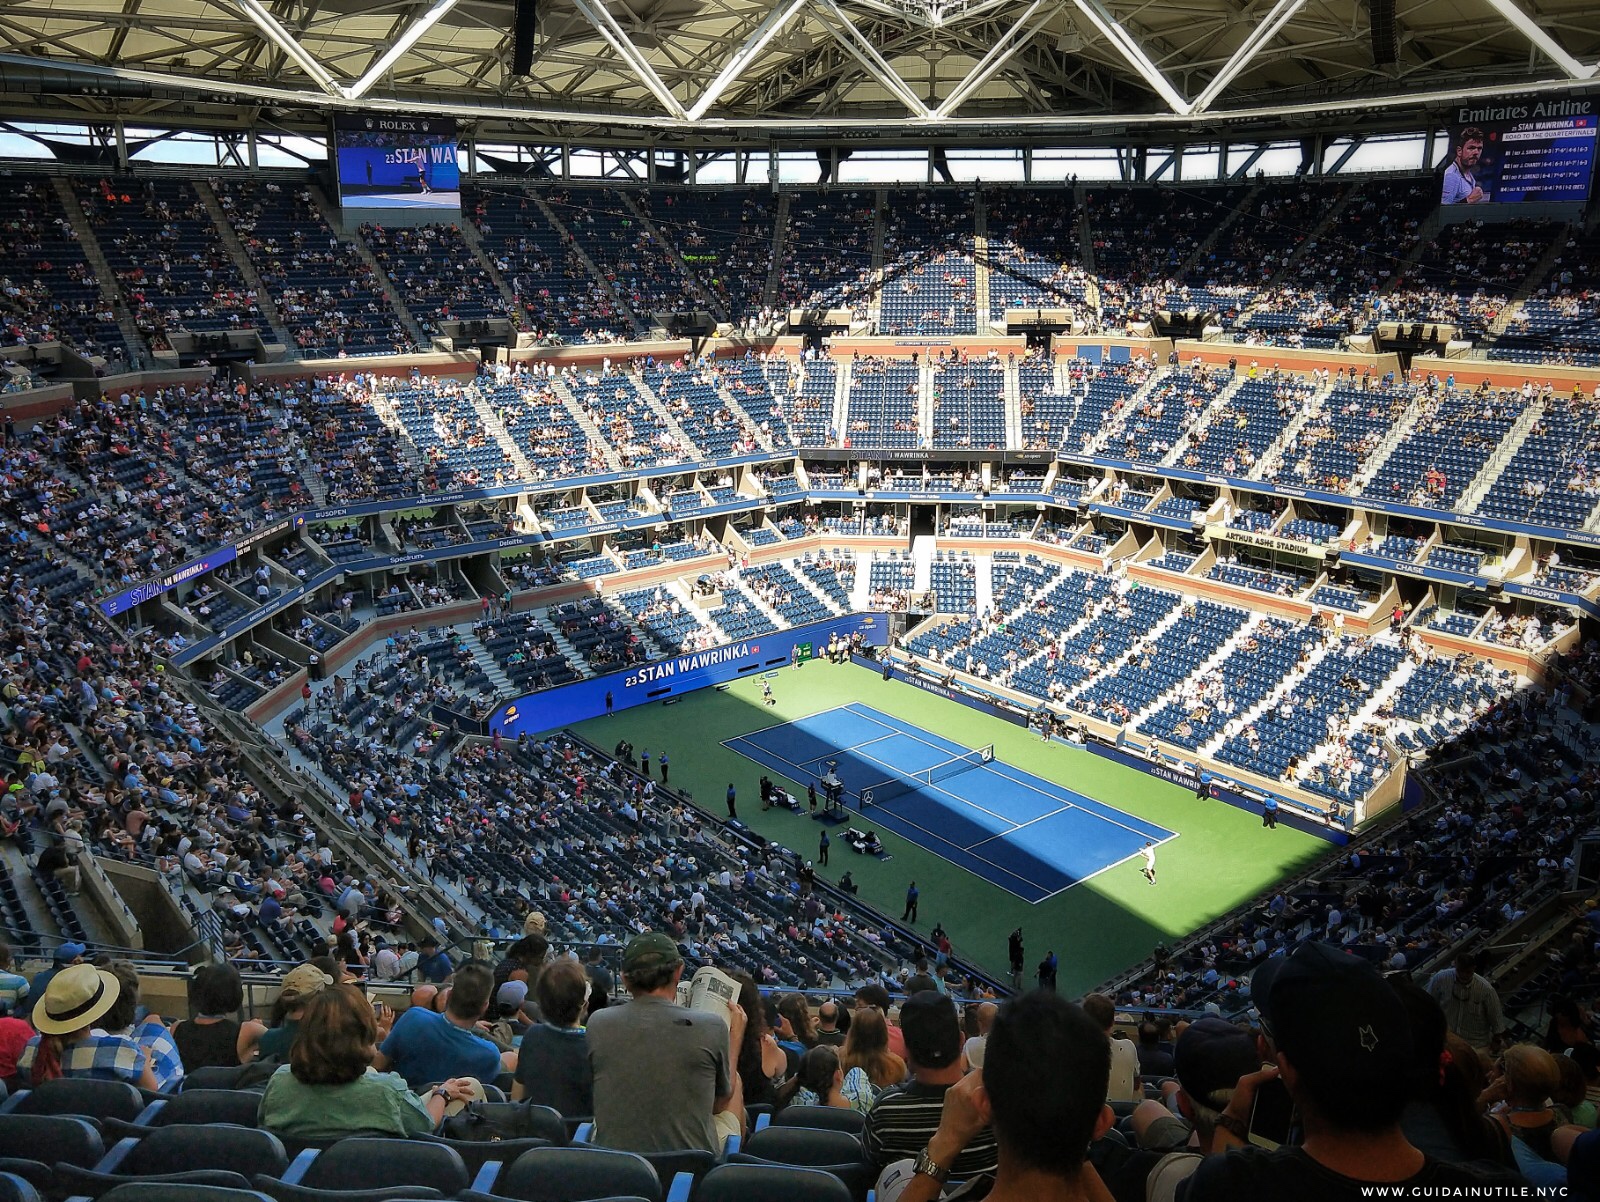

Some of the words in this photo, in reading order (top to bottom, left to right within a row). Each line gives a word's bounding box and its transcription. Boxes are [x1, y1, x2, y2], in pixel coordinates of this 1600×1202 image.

[1458, 106, 1528, 122] Emirates
[1532, 100, 1591, 117] Airline
[380, 120, 416, 130] ROLEX
[1536, 120, 1574, 130] WAWRINKA
[1544, 129, 1594, 137] QUARTERFINALS
[386, 154, 394, 163] 23
[396, 148, 427, 163] STAN
[1226, 532, 1253, 544] ARTHUR
[1255, 538, 1274, 547] ASHE
[1276, 541, 1309, 555] STADIUM
[1566, 533, 1592, 542] Emirates
[390, 554, 423, 564] Spectrum
[1396, 563, 1424, 575] CHASE
[130, 578, 163, 606] STAN
[173, 563, 203, 582] WAWRINKA
[1521, 587, 1560, 601] #USOPEN
[625, 676, 637, 687] 23
[638, 661, 675, 684] STAN
[679, 643, 749, 673] WAWRINKA
[909, 676, 922, 686] STAN
[922, 681, 950, 696] WAWRINKA
[1156, 767, 1172, 779] STAN
[1172, 773, 1201, 789] WAWRIN
